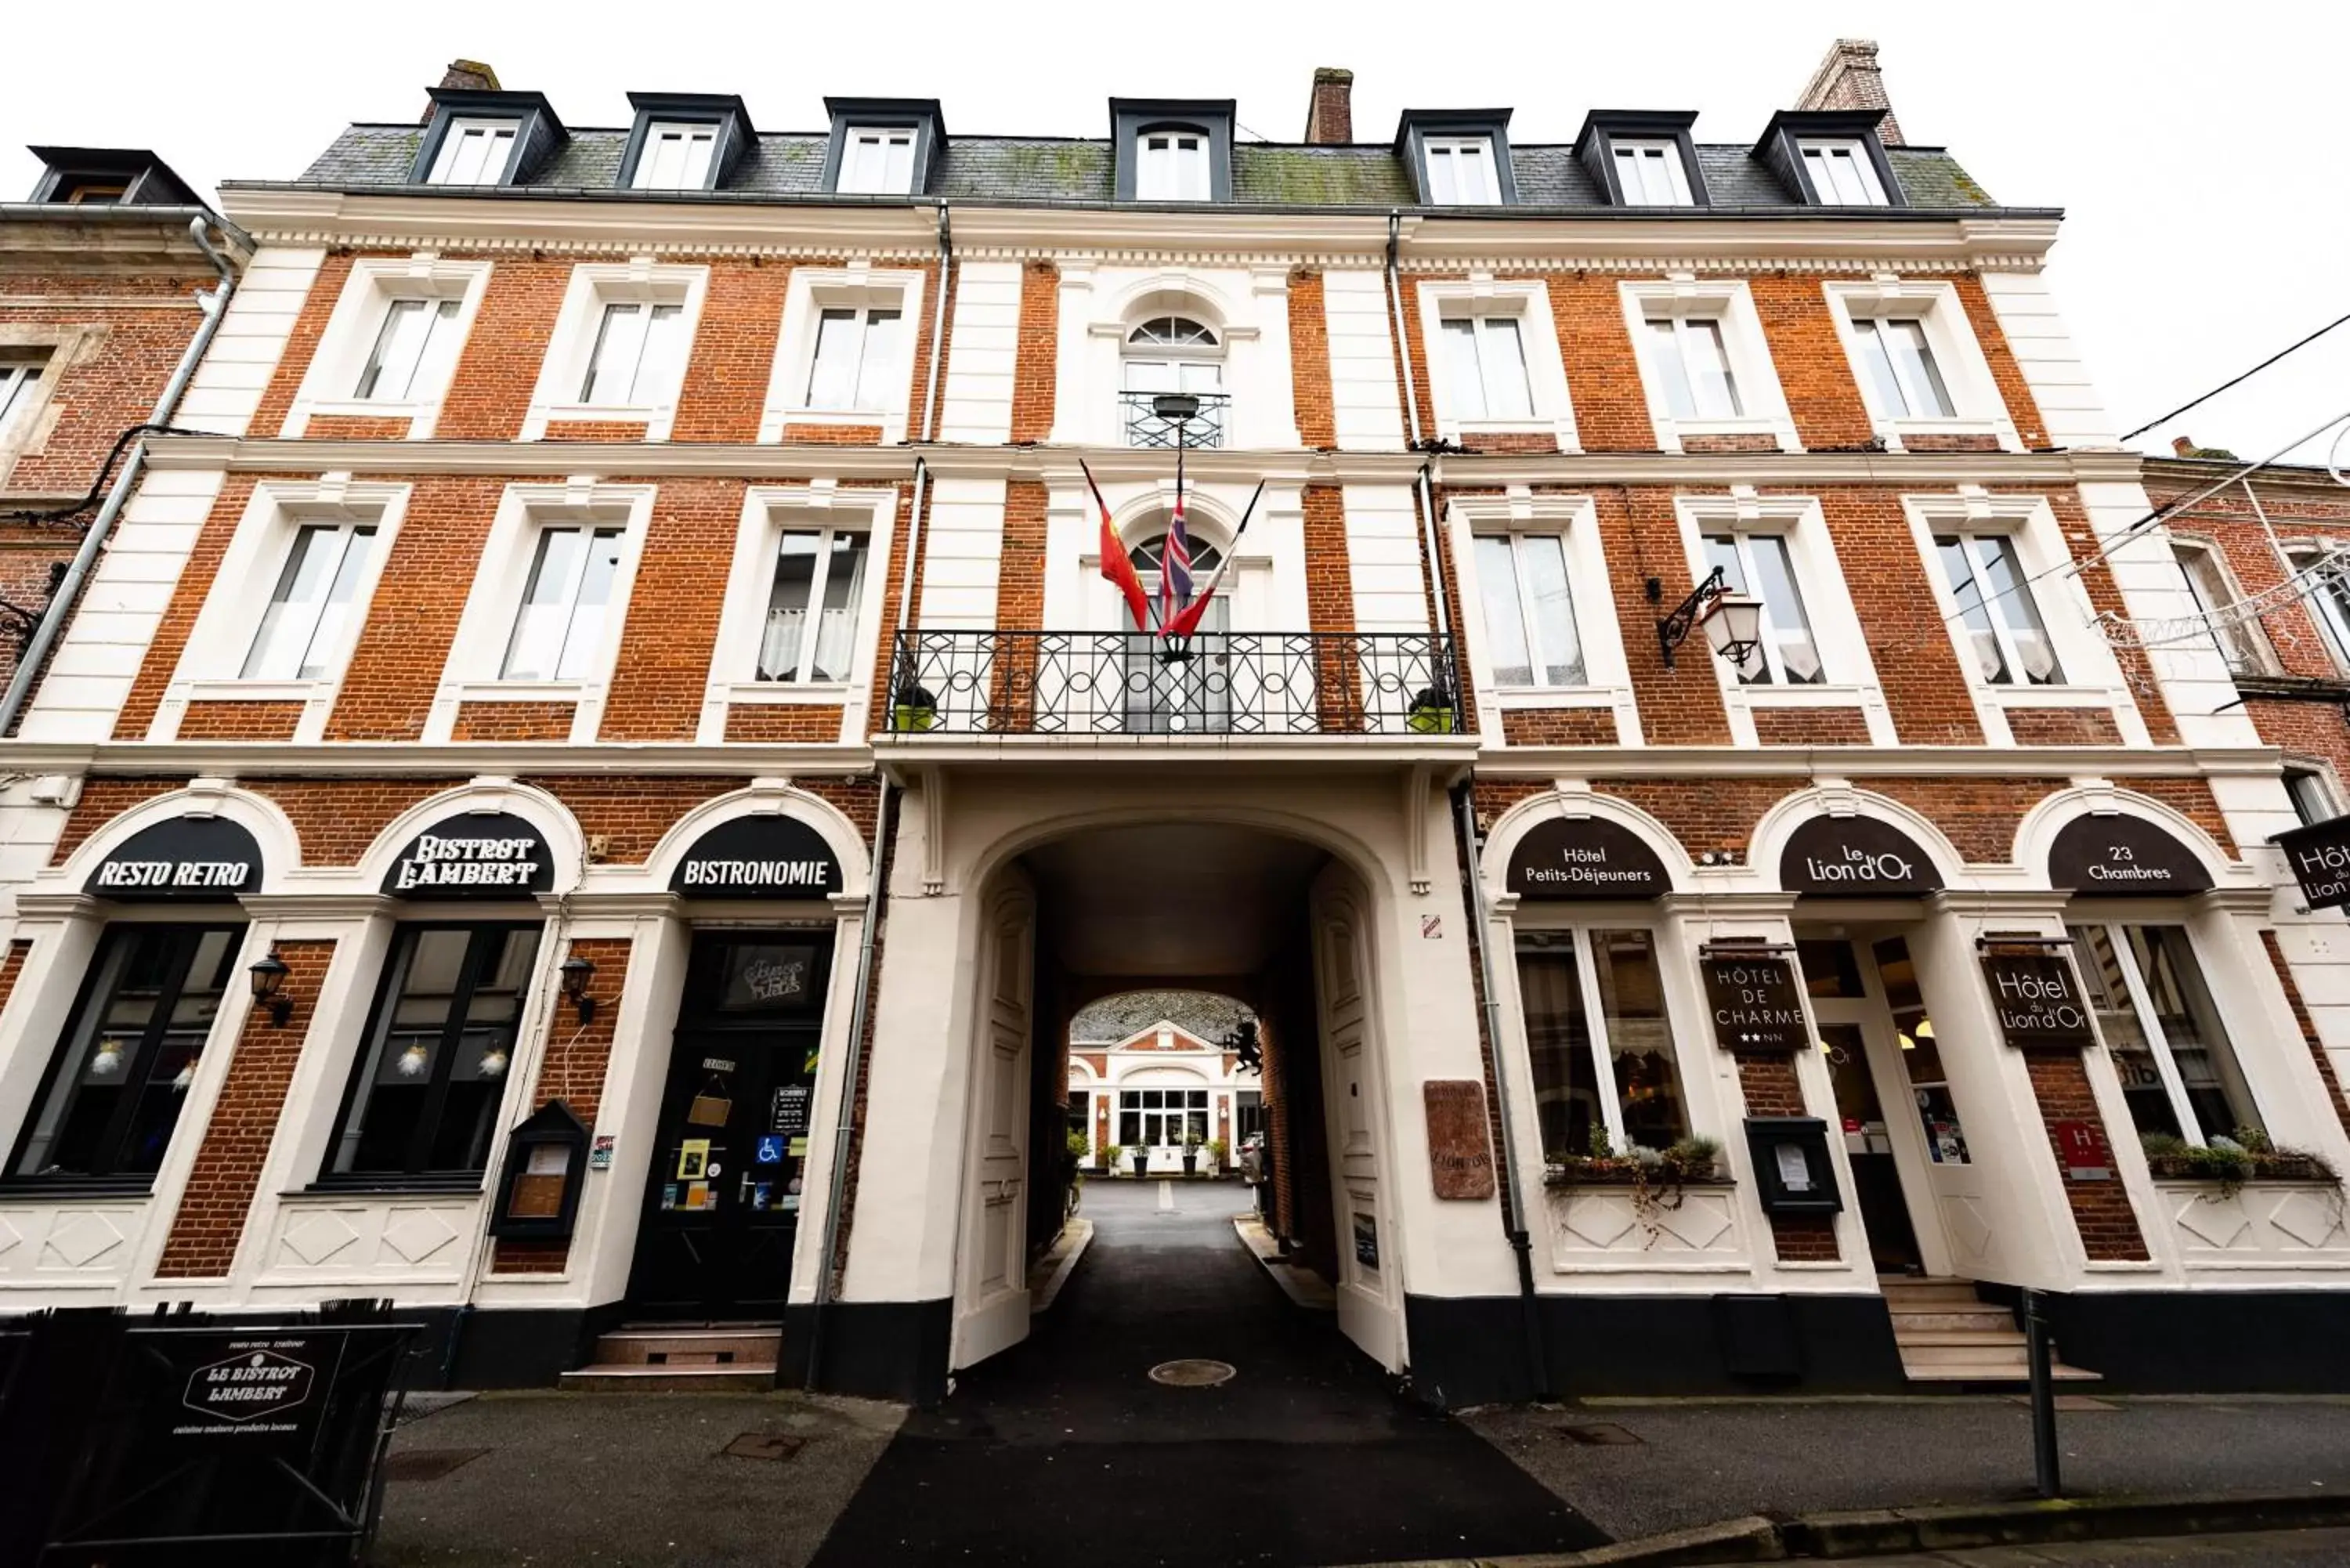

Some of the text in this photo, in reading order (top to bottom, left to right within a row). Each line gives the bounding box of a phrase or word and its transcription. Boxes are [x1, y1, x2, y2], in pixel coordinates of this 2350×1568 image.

[414, 835, 537, 864] BISTROT
[1563, 847, 1606, 862] Hôtel
[1842, 844, 1864, 861] Le
[2109, 847, 2133, 861] 23
[97, 861, 249, 886] RESTO RETRO
[394, 858, 539, 889] LAMBERT
[684, 861, 828, 885] BISTRONOMIE
[1525, 866, 1651, 886] Petits-Déjeuners
[1806, 853, 1912, 880] Lion d'Or
[2088, 864, 2171, 879] Chambres
[2305, 881, 2347, 900] Lion
[1716, 966, 1783, 985] HÔTEL
[1995, 970, 2069, 999] Hôtel
[1741, 989, 1768, 1004] DE
[1716, 1009, 1804, 1025] CHARME
[2000, 1005, 2085, 1028] Lion d'Or
[2073, 1129, 2092, 1146] H
[206, 1366, 302, 1382] LE BISTROT
[207, 1386, 288, 1402] LAMBERT
